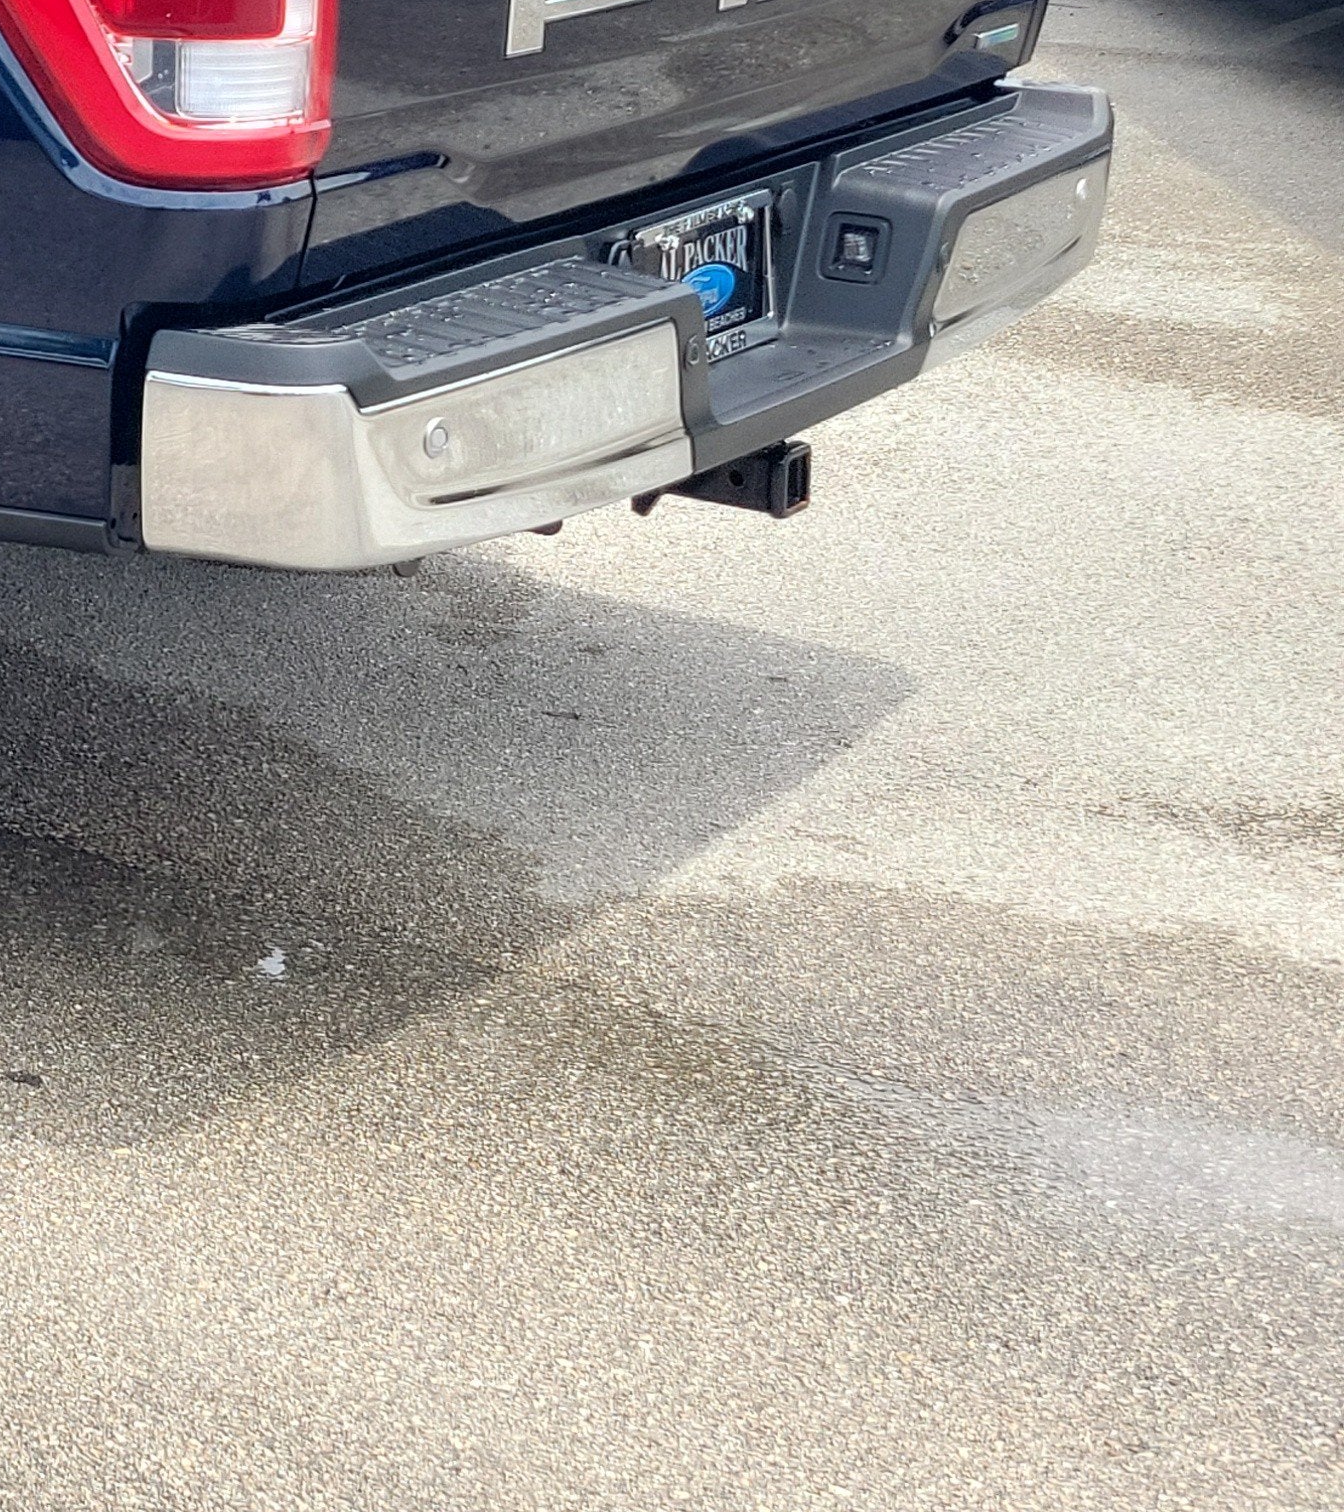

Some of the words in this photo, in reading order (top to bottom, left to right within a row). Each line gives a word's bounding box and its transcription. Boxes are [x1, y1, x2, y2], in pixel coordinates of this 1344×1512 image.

[683, 224, 749, 273] PACKER
[708, 306, 747, 332] BEACHES
[706, 328, 748, 360] CKER
